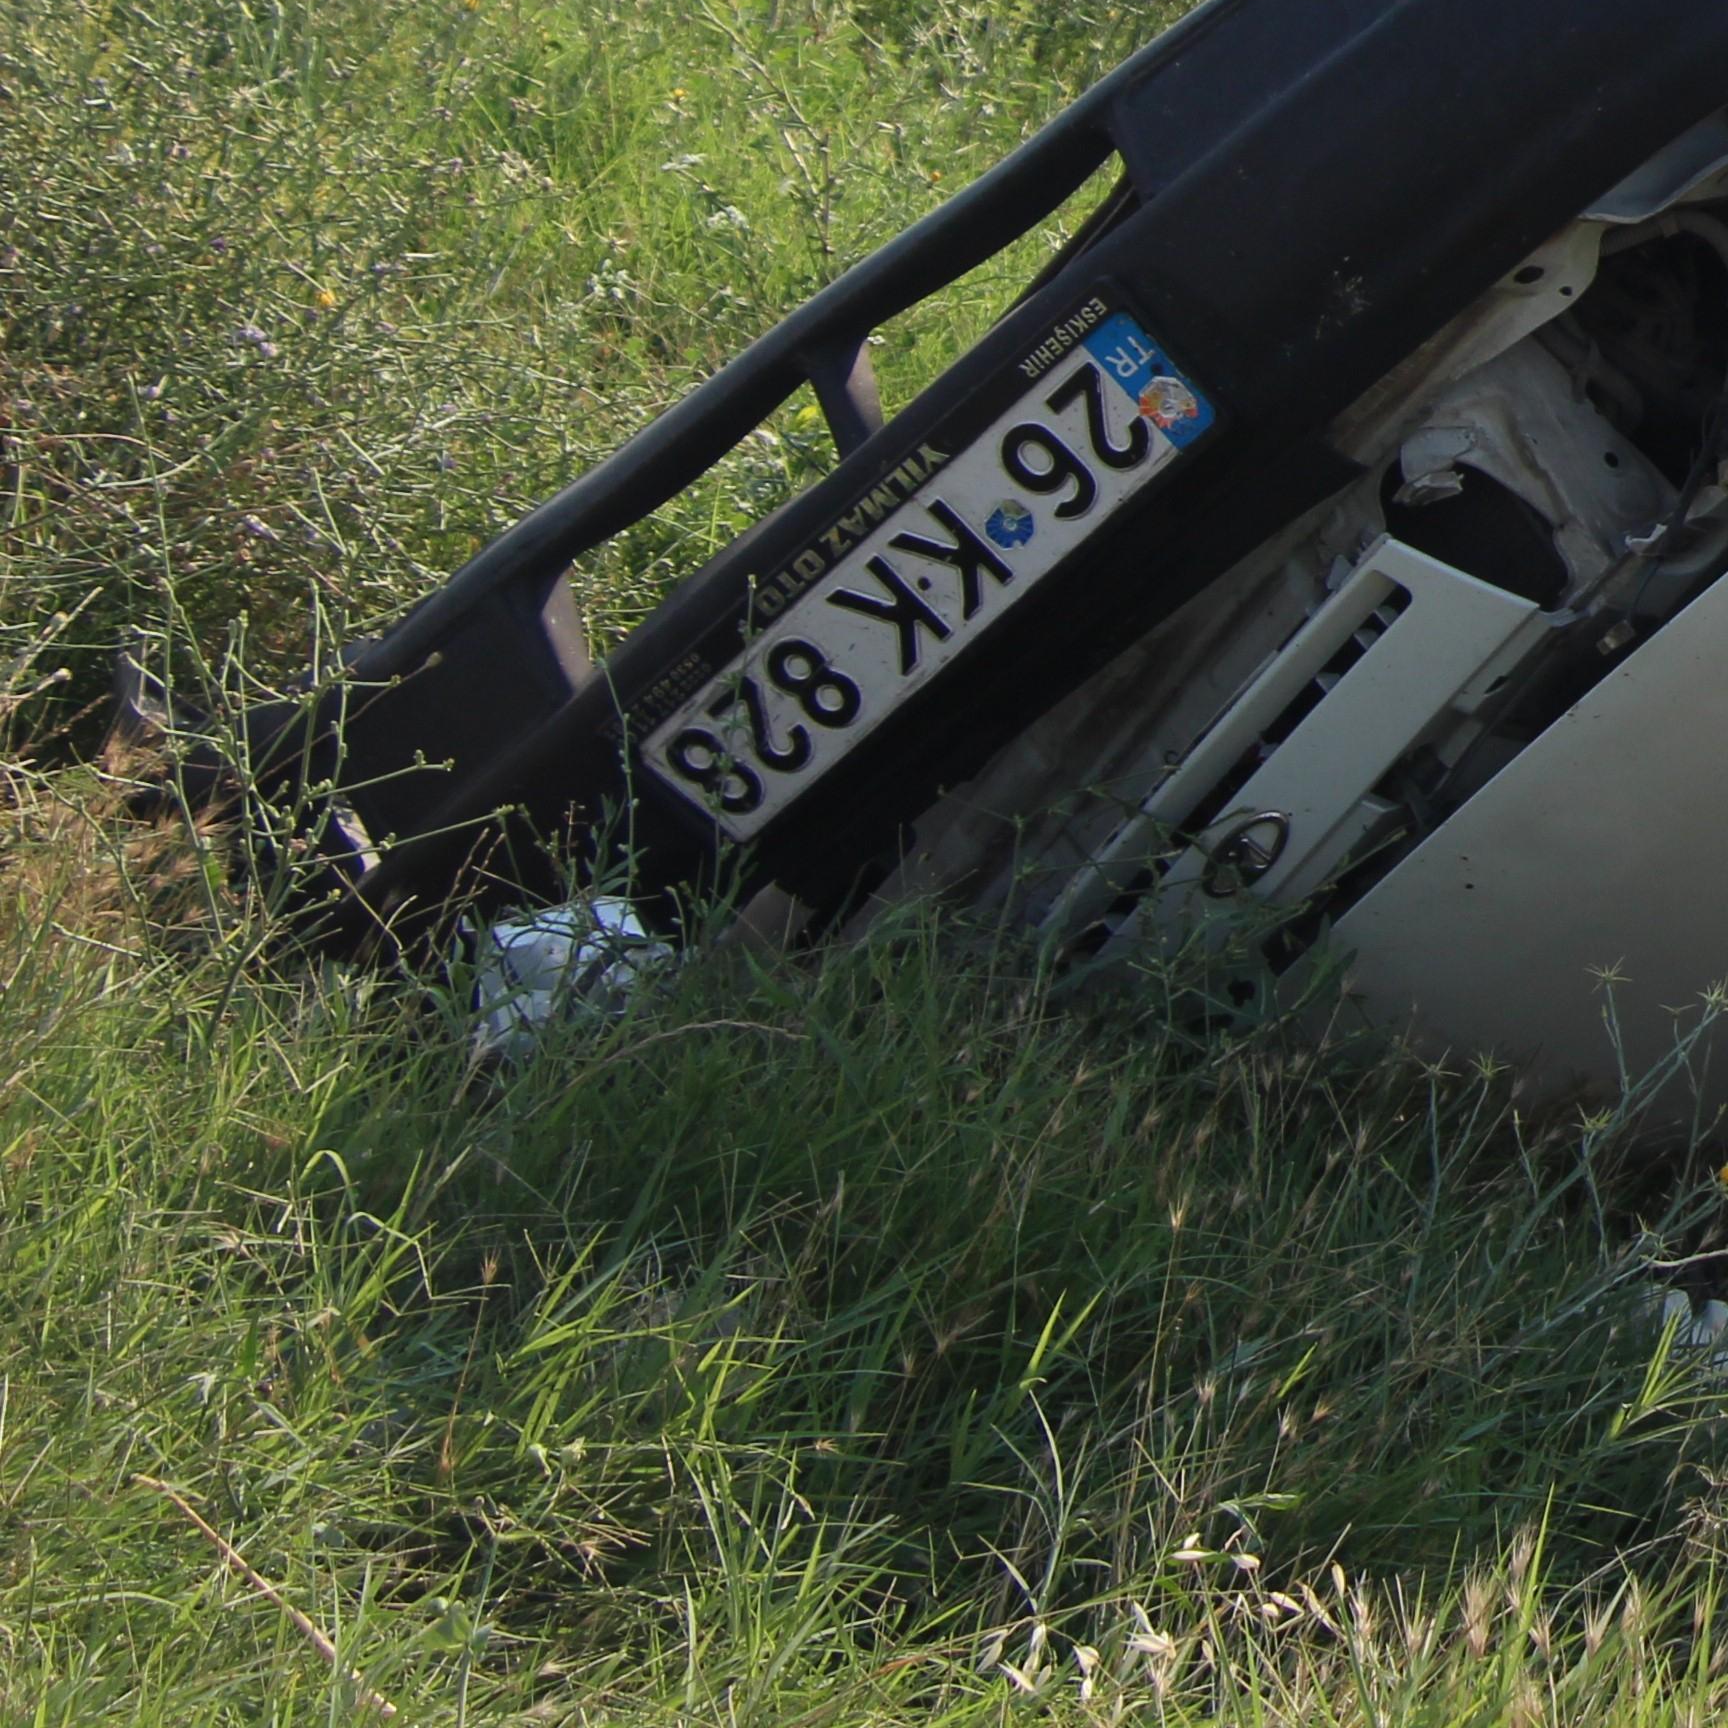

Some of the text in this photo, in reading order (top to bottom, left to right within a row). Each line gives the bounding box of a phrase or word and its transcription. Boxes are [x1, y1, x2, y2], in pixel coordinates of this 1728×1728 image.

[1105, 336, 1155, 377] TR
[665, 361, 1150, 815] 26 KK 828
[754, 441, 950, 619] YILMAZ OTO
